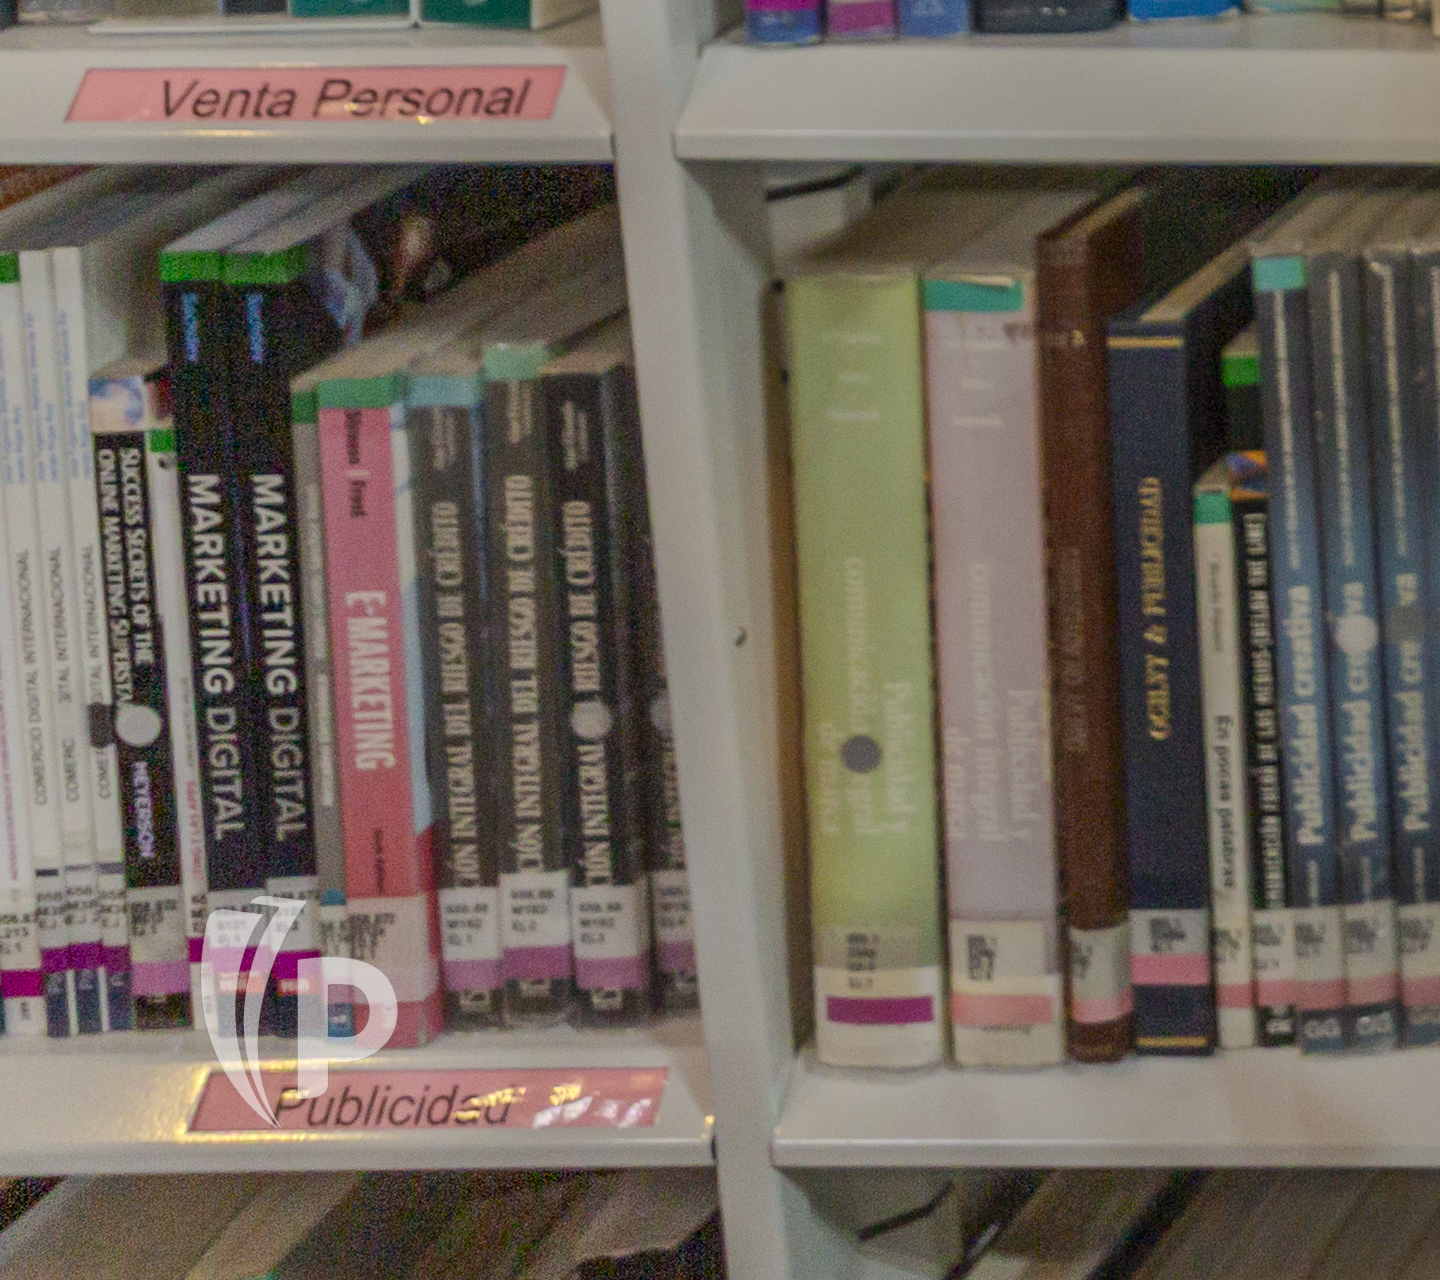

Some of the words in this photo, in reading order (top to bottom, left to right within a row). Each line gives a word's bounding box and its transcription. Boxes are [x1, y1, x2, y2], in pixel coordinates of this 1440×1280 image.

[162, 80, 297, 118] Venta
[313, 79, 531, 118] Personal
[187, 473, 236, 696] MARKETING
[250, 473, 298, 696] MARKETING
[203, 707, 245, 840] DIGITAL
[267, 707, 308, 841] DIGITAL
[1288, 703, 1325, 845] Publicidad
[1344, 699, 1381, 842] Publicidad
[1398, 689, 1433, 832] Publicidad
[275, 1086, 511, 1127] Publicidad
